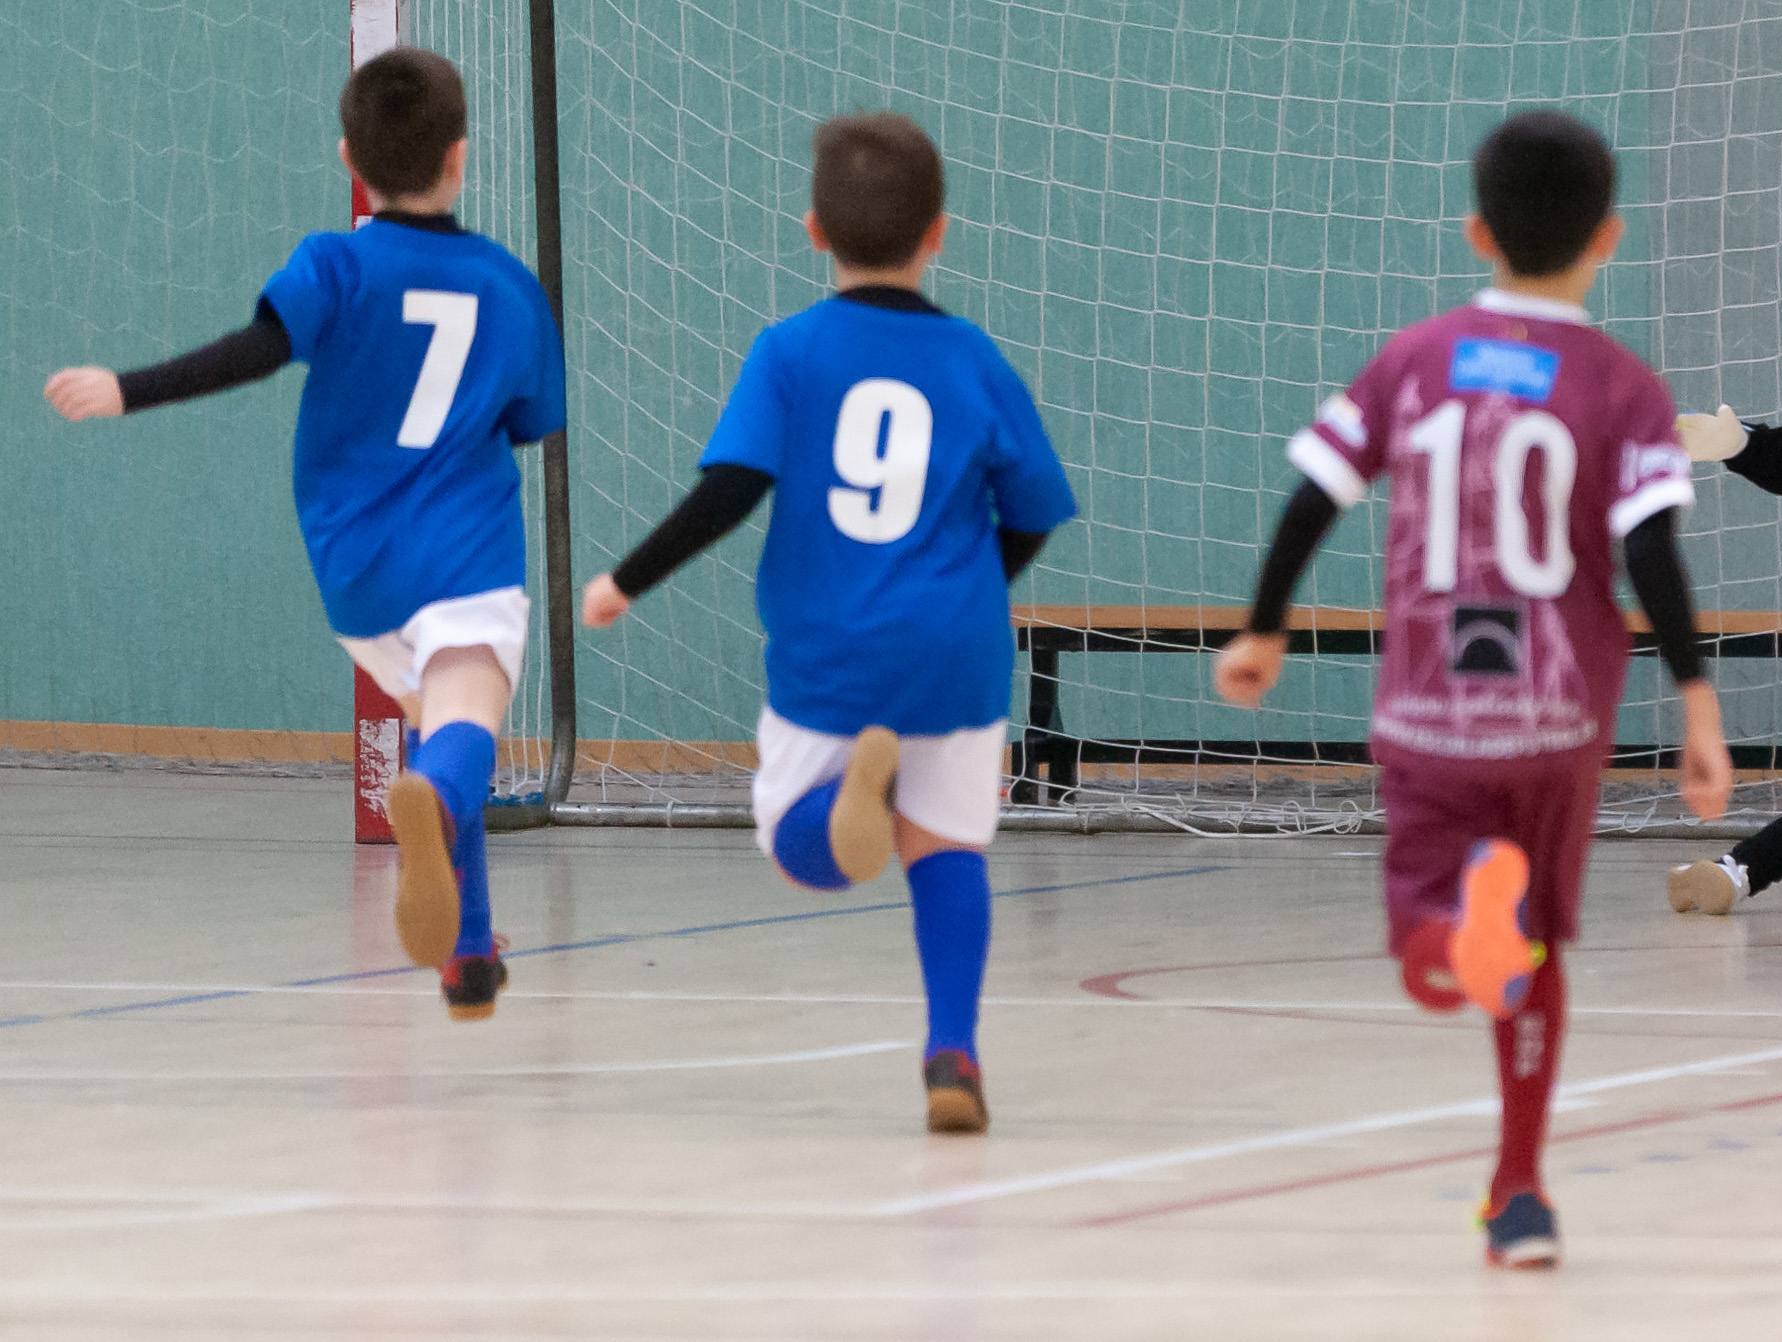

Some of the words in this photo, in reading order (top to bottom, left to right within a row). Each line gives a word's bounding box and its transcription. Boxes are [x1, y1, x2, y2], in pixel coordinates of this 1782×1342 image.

[396, 288, 480, 449] 7
[827, 376, 934, 546] 9
[1403, 397, 1578, 600] 10
